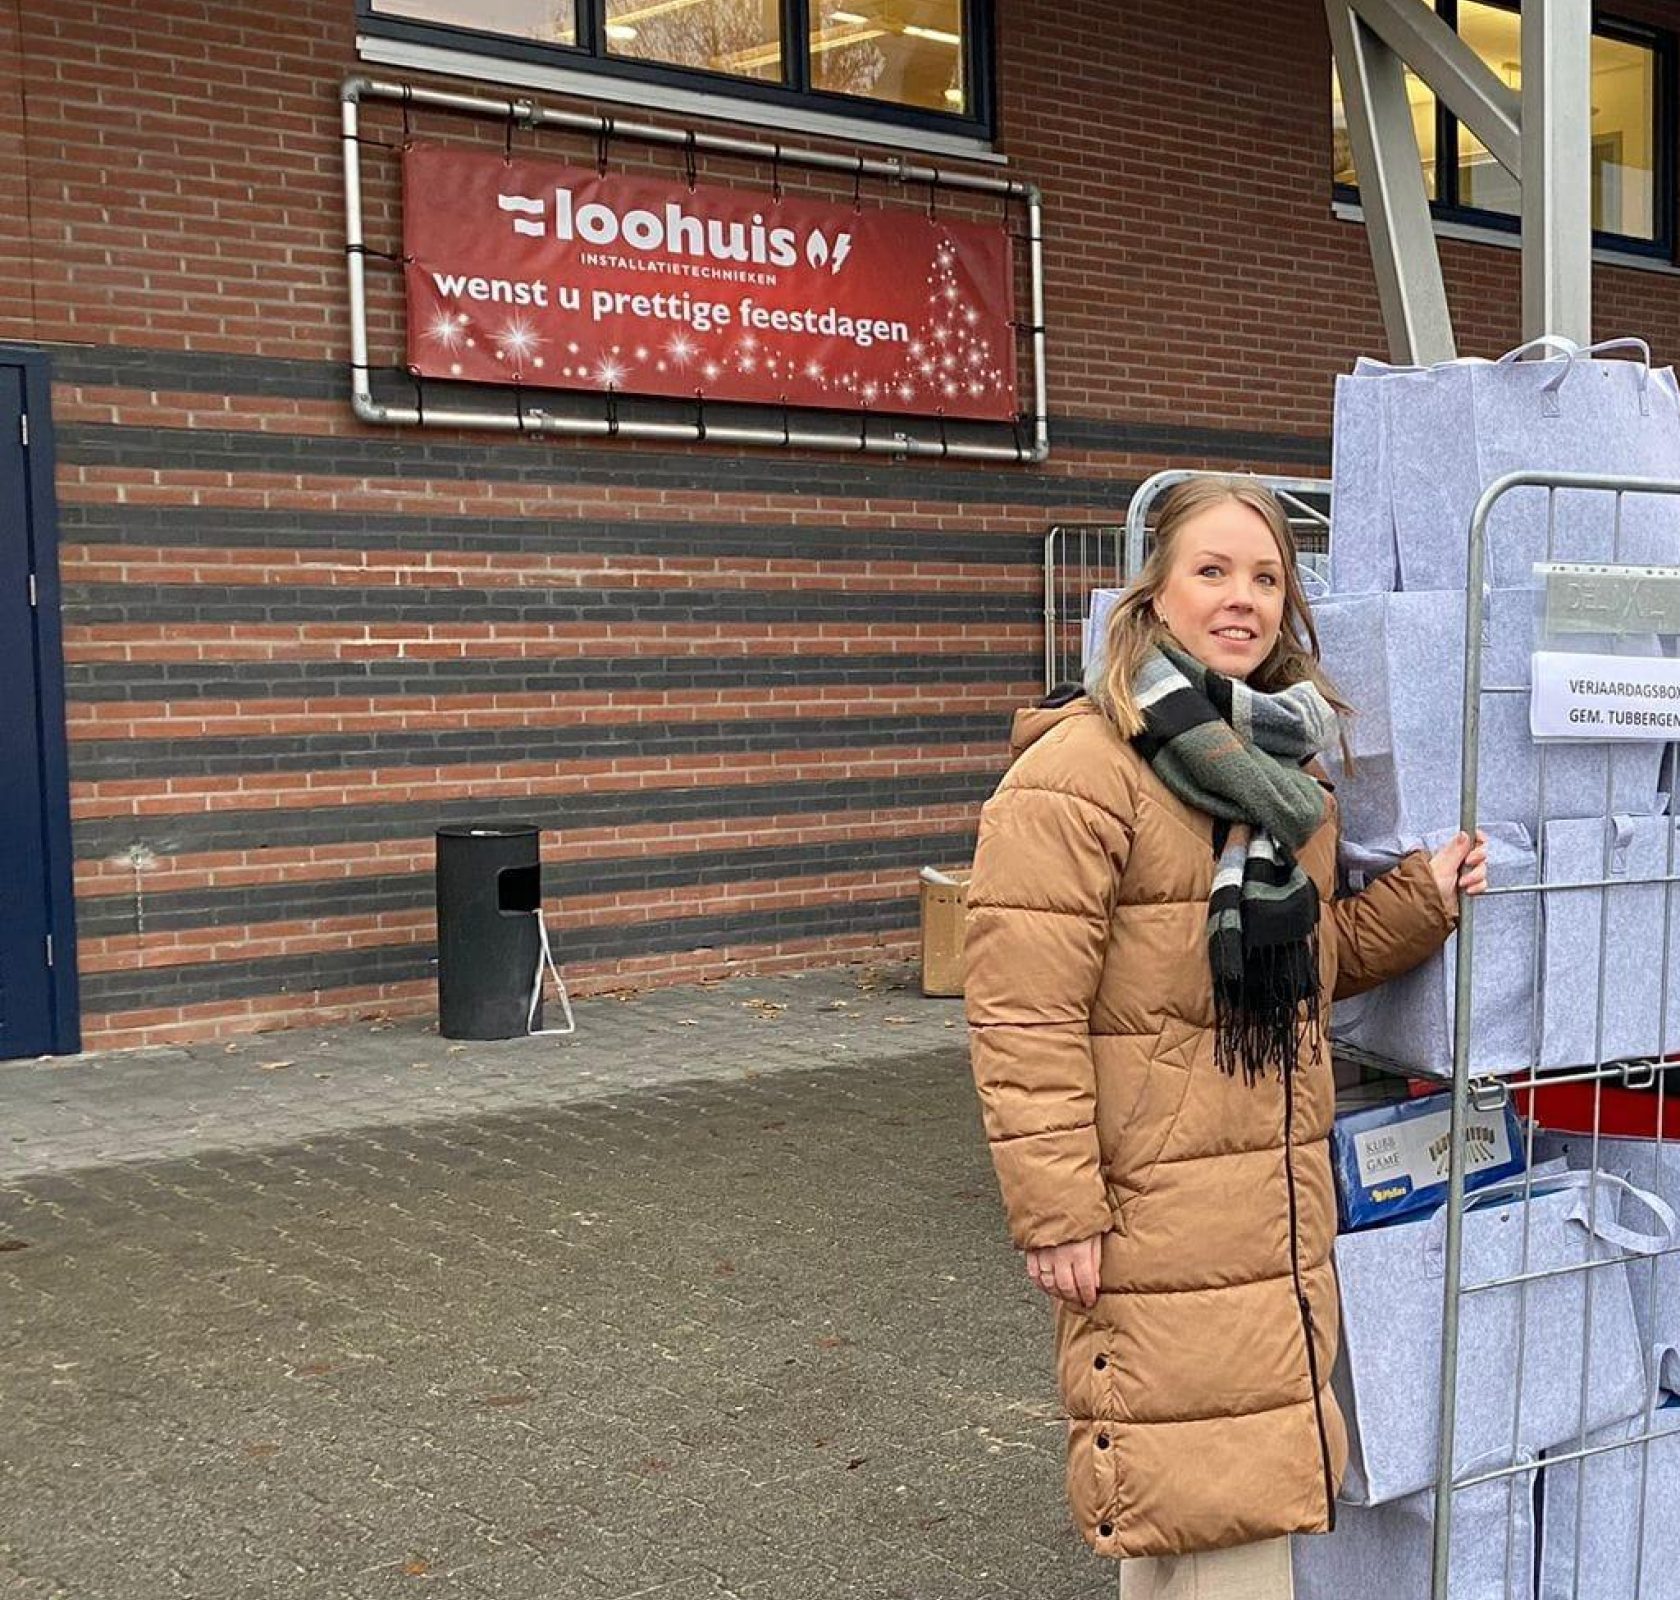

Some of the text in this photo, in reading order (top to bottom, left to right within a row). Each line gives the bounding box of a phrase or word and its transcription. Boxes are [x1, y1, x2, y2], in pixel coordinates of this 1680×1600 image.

[556, 187, 798, 267] loohuis
[581, 253, 777, 286] INSTALLATIETECHNIEKEN
[432, 272, 909, 347] wenst u prettige feestdagen
[1569, 708, 1604, 724] GEM.
[1367, 1153, 1399, 1171] GAME
